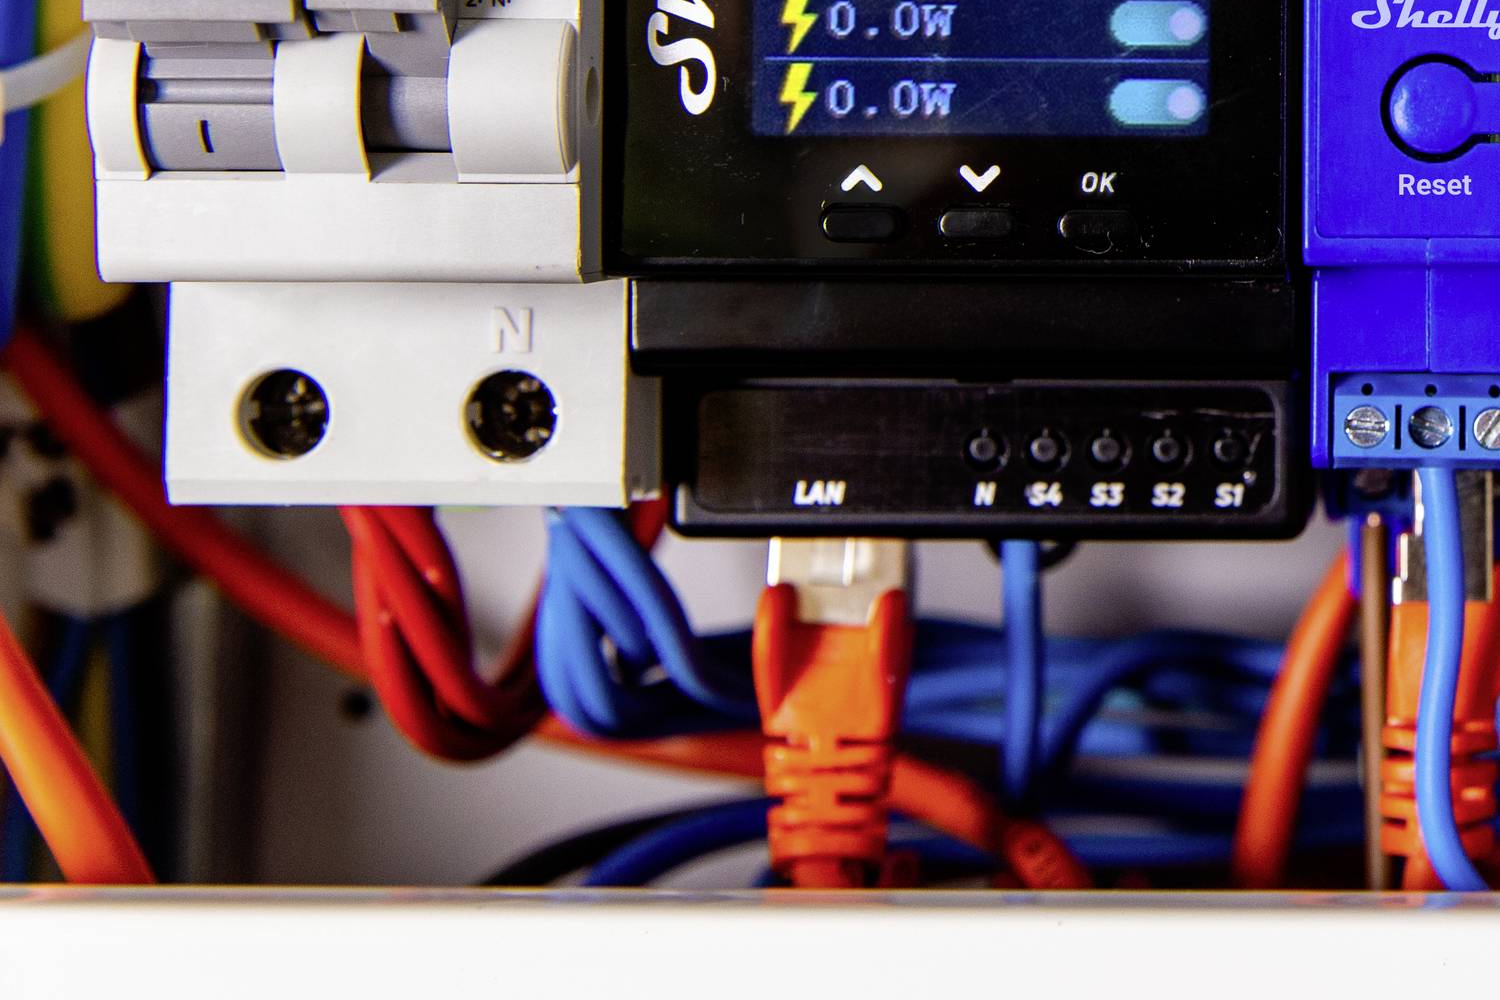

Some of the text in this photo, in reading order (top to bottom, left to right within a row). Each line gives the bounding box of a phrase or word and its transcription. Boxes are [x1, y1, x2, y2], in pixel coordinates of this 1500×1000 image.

[829, 1, 956, 38] 0.0W
[828, 80, 956, 118] 0.0W
[1082, 172, 1116, 192] OK
[1399, 174, 1472, 195] Reset
[493, 307, 532, 353] N
[795, 481, 845, 505] LAN
[975, 482, 1244, 507] N S4 S3 S2 S1
